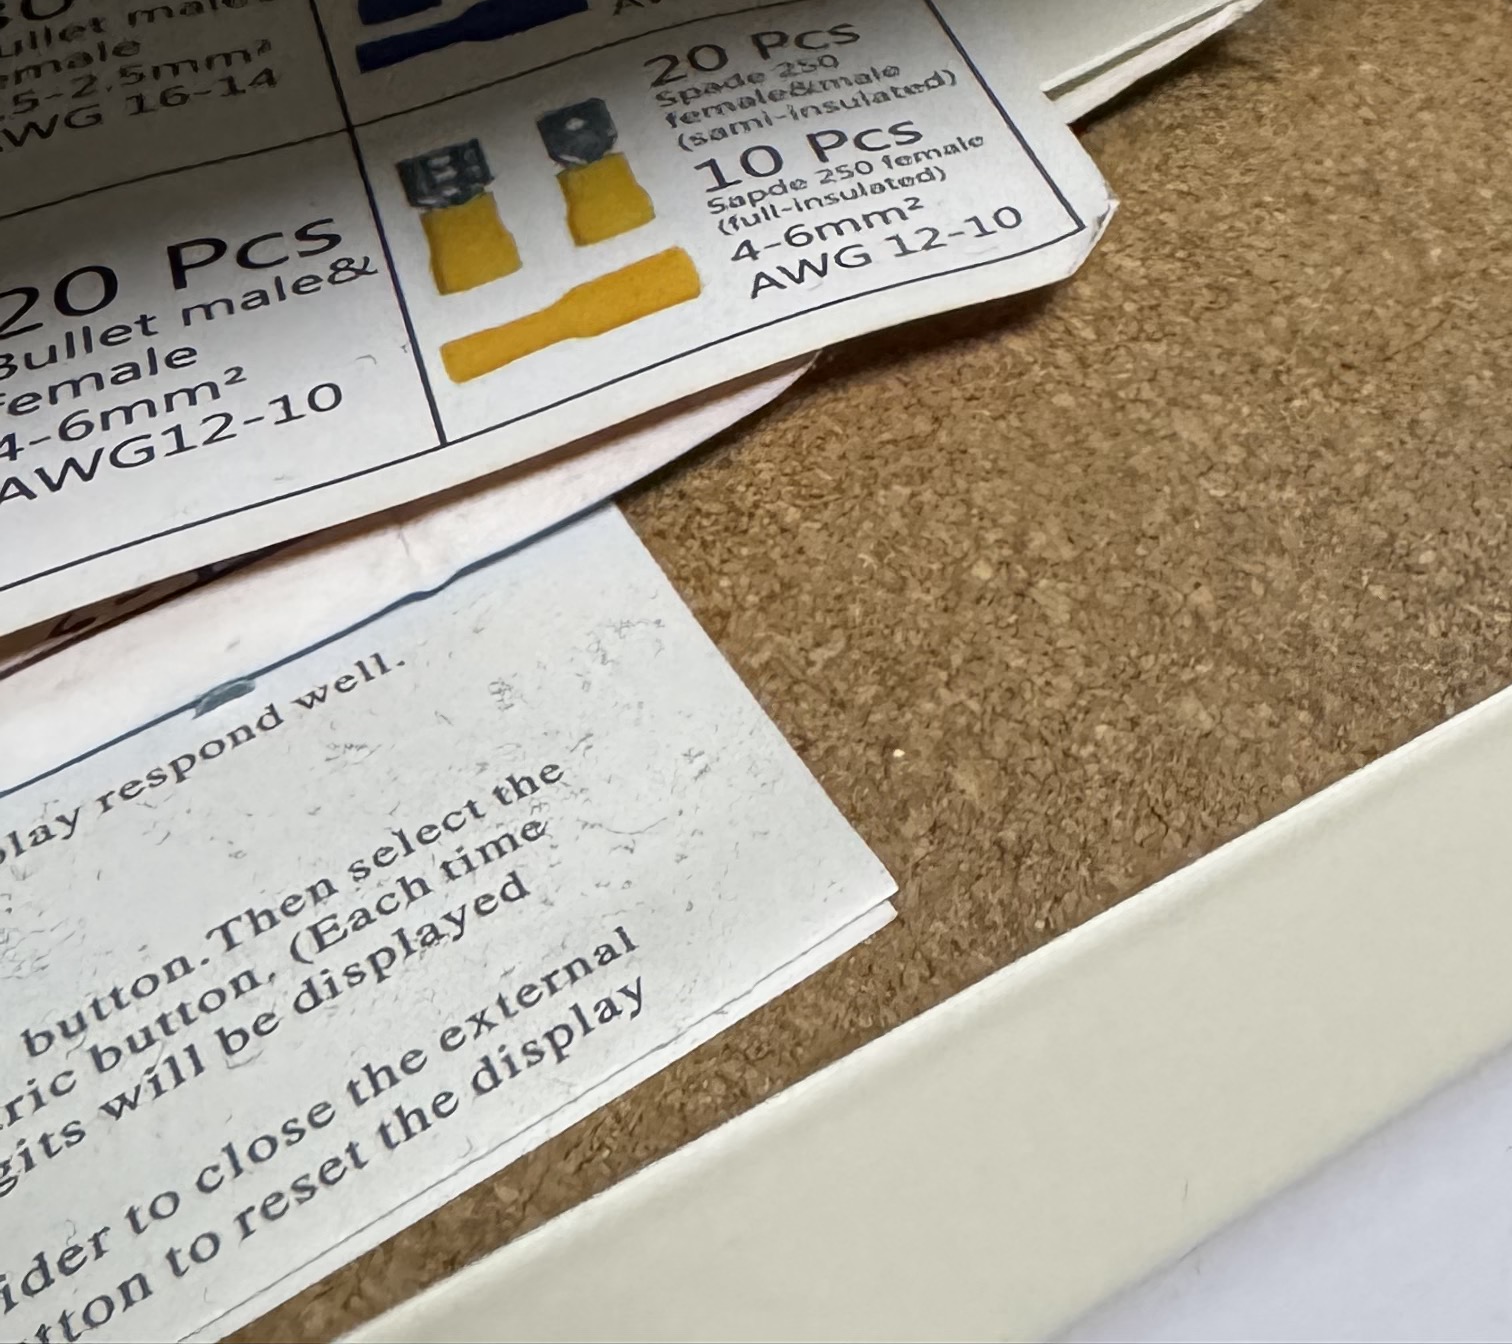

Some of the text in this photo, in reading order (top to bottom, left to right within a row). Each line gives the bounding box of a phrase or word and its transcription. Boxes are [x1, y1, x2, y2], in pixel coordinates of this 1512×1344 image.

[643, 23, 861, 87] 20 Pcs
[655, 54, 840, 108] Spade 250
[664, 64, 900, 129] female&male
[0, 67, 279, 153] WG 16-14
[694, 120, 923, 193] 10 Pcs
[707, 134, 985, 215] Sapde 250 female
[717, 164, 948, 236] (full-insulated)
[0, 217, 342, 339] 20 Pcs
[181, 255, 378, 327] male&
[750, 205, 1023, 300] AWG 12-10
[95, 703, 285, 814] respond
[290, 652, 406, 711] well.
[347, 799, 487, 883] select
[492, 762, 565, 807] the
[0, 1069, 77, 1132] ric
[289, 876, 434, 966] (Each
[440, 818, 550, 882] time
[98, 1043, 206, 1121] will
[214, 1011, 281, 1056] be
[292, 870, 532, 1014] displayed
[125, 1190, 180, 1236] to
[195, 1099, 336, 1194] close
[346, 1046, 428, 1107] the
[439, 925, 640, 1053] external
[165, 1231, 221, 1278] to
[232, 1139, 369, 1243] reset
[376, 1088, 461, 1151] the
[470, 975, 645, 1096] display
